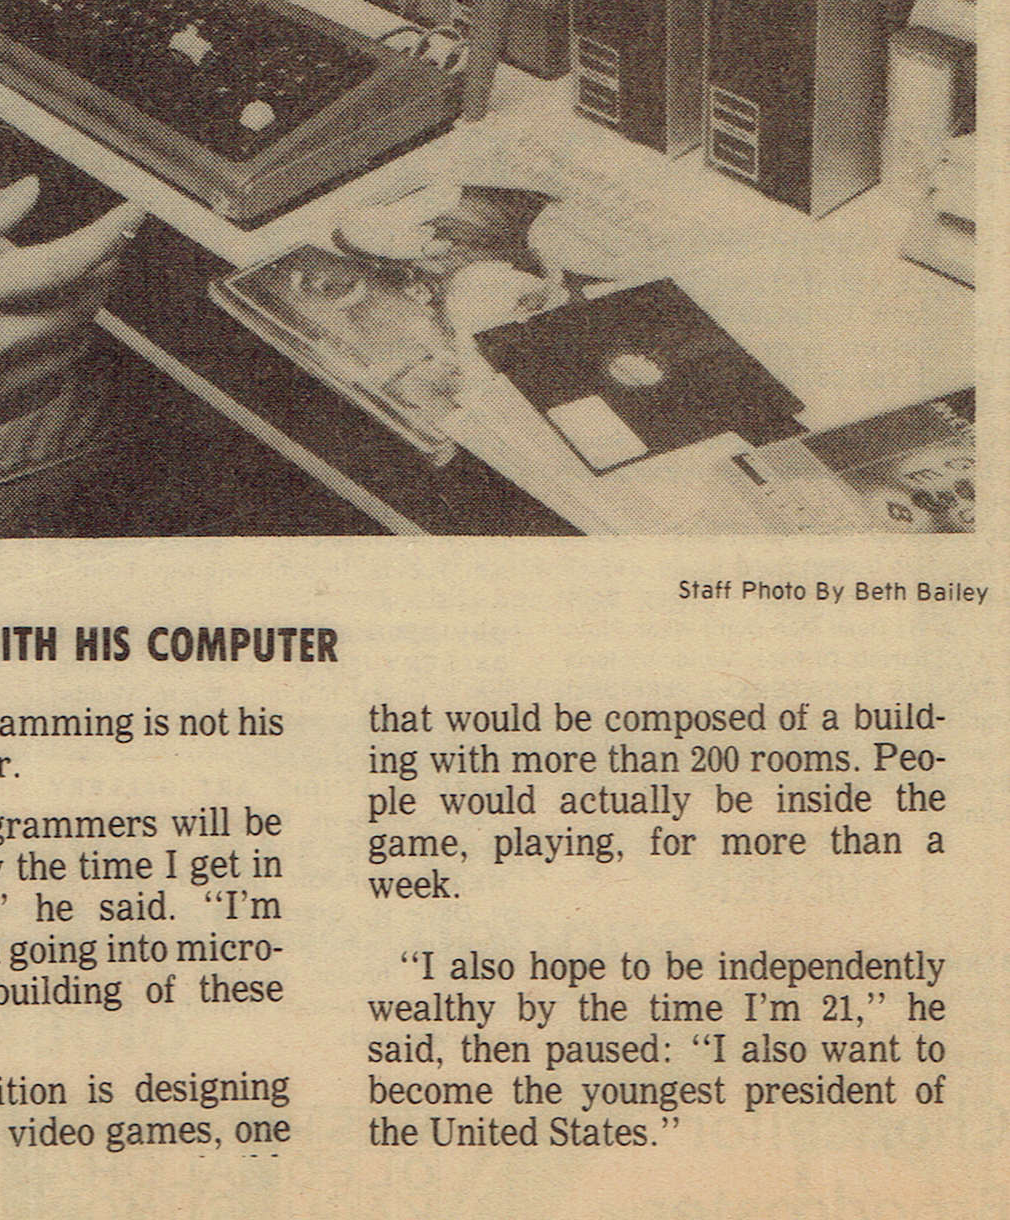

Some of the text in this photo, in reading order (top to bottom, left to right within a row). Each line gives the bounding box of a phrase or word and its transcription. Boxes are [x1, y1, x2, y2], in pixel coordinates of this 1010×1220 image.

[678, 579, 989, 606] Staff Photo By Beth Bailey
[75, 625, 131, 662] HIS
[146, 626, 339, 663] COMPUTER
[143, 706, 170, 737] is
[178, 707, 230, 737] not
[237, 706, 285, 737] his
[368, 701, 946, 740] that would be composed of a build-
[368, 741, 947, 782] ing with more than 200 rooms. Peo-
[367, 781, 946, 824] ple would actually be inside the
[368, 824, 946, 865] game, playing, for more than a
[16, 850, 67, 882] the
[78, 849, 154, 881] time
[164, 849, 178, 880] I
[190, 849, 242, 888] get
[252, 848, 283, 879] in
[367, 868, 460, 900] week.
[9, 933, 98, 972] going
[106, 933, 169, 963] into
[175, 931, 284, 963] micro-
[449, 950, 516, 981] also
[529, 950, 607, 989] hope
[620, 951, 651, 981] to
[665, 950, 704, 981] be
[717, 949, 947, 989] independently
[145, 973, 177, 1005] of
[198, 972, 284, 1004] these
[87, 1073, 114, 1104] is
[134, 1070, 291, 1110] designing
[367, 1073, 947, 1113] become the youngest president of
[7, 1115, 96, 1148] video
[105, 1121, 222, 1154] games,
[234, 1119, 293, 1144] one
[368, 1115, 419, 1147] the
[428, 1115, 539, 1147] United
